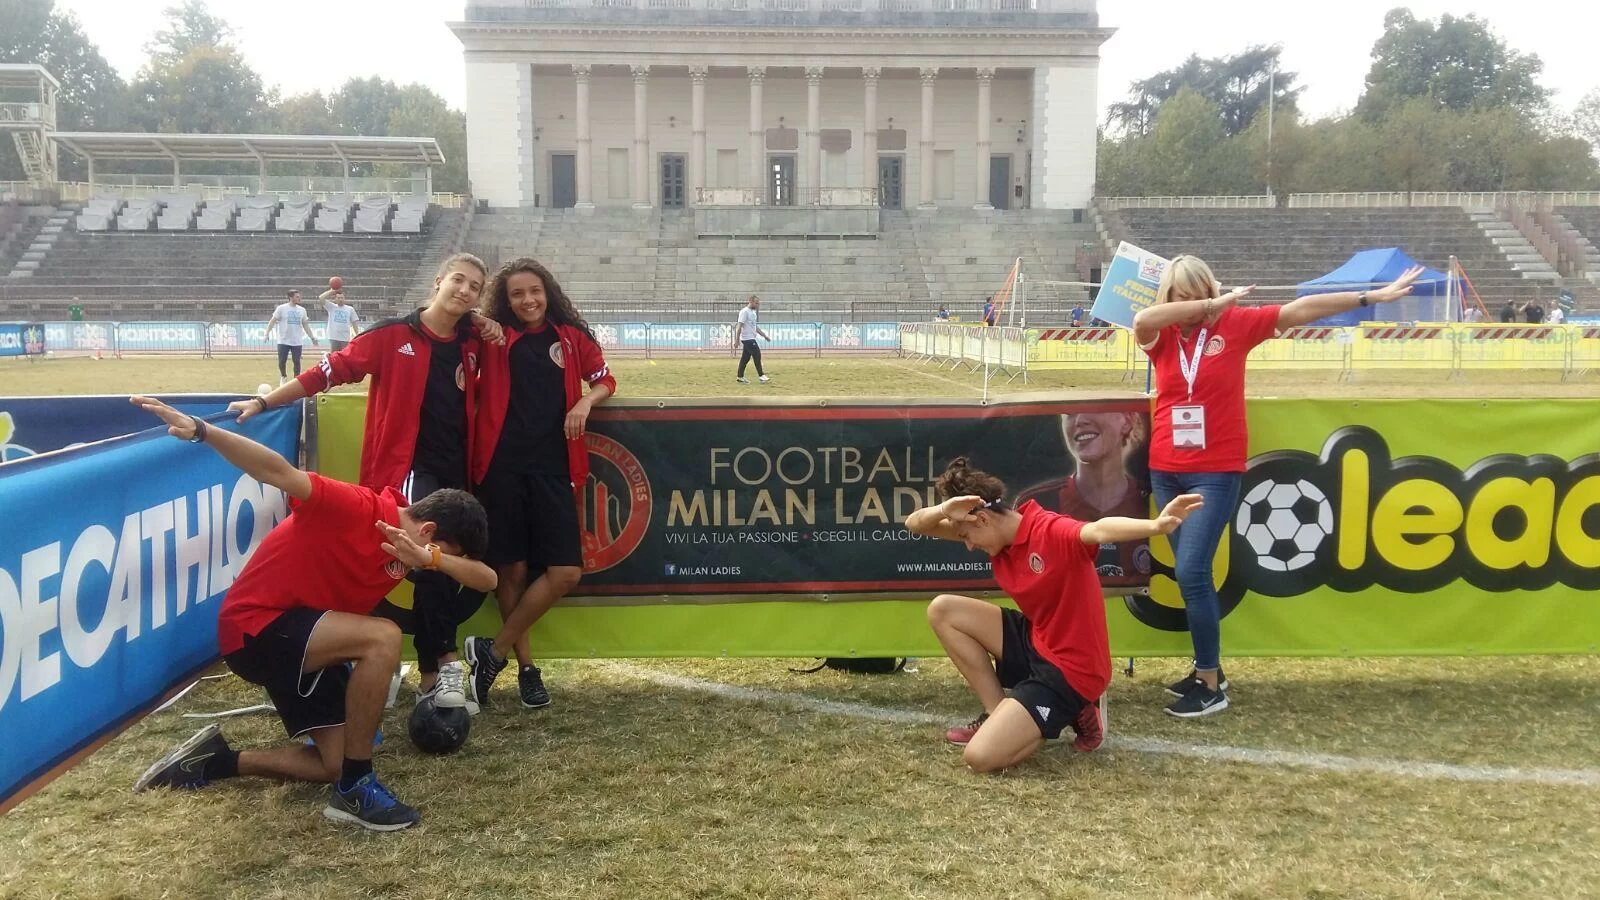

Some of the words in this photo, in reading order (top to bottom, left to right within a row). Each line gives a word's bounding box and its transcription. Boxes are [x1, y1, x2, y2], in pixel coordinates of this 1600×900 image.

[711, 446, 941, 485] FOOTBALL
[622, 457, 648, 501] LADIES
[667, 488, 816, 526] MILAN
[665, 532, 689, 543] VIVI
[693, 532, 709, 544] LA
[712, 532, 735, 543] TUA
[739, 531, 798, 543] PASSIONE
[812, 530, 856, 542] SCEGLI
[859, 530, 869, 541] IL
[679, 566, 708, 576] MILAN
[711, 566, 741, 576] LADIES
[897, 561, 993, 573] WWW.MILANLADIES.IT
